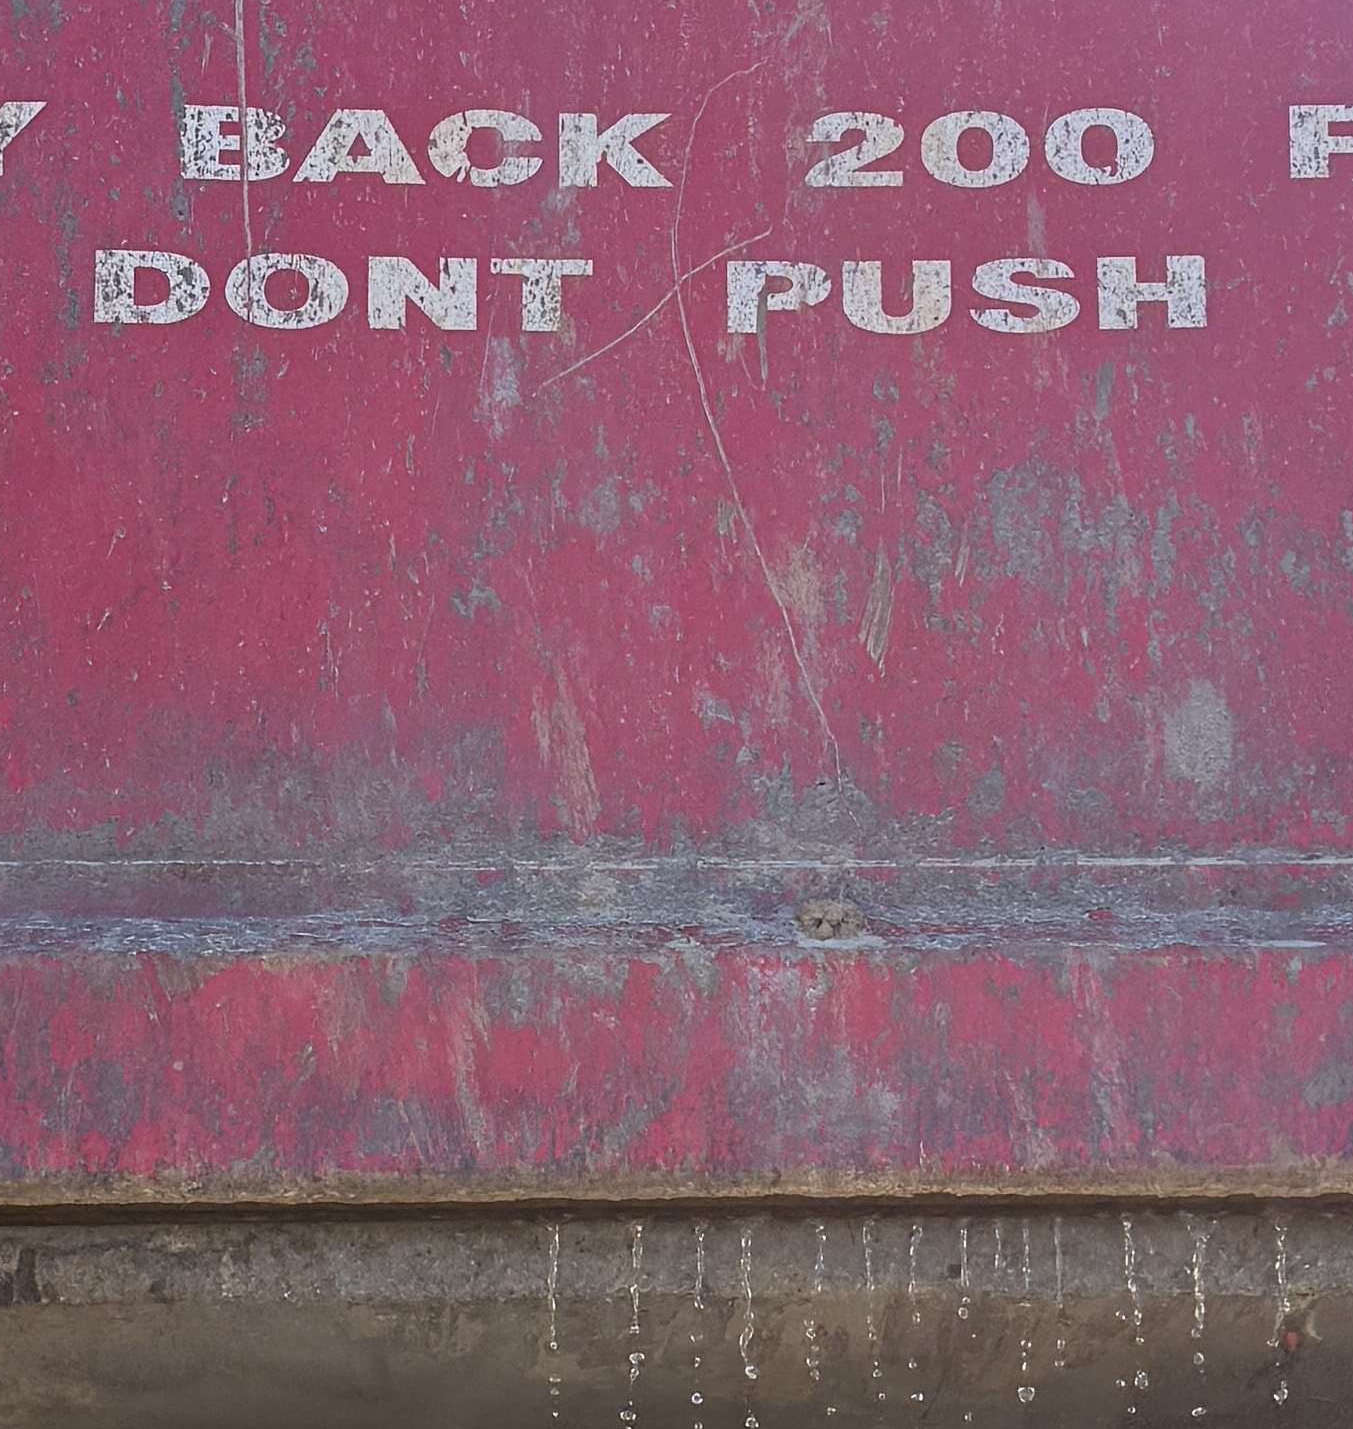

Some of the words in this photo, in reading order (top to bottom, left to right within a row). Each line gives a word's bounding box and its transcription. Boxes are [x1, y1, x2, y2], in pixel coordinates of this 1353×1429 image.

[180, 104, 673, 188] BACK
[805, 107, 1155, 188] 200
[94, 249, 593, 332] DONT
[726, 255, 1207, 334] PUSH
